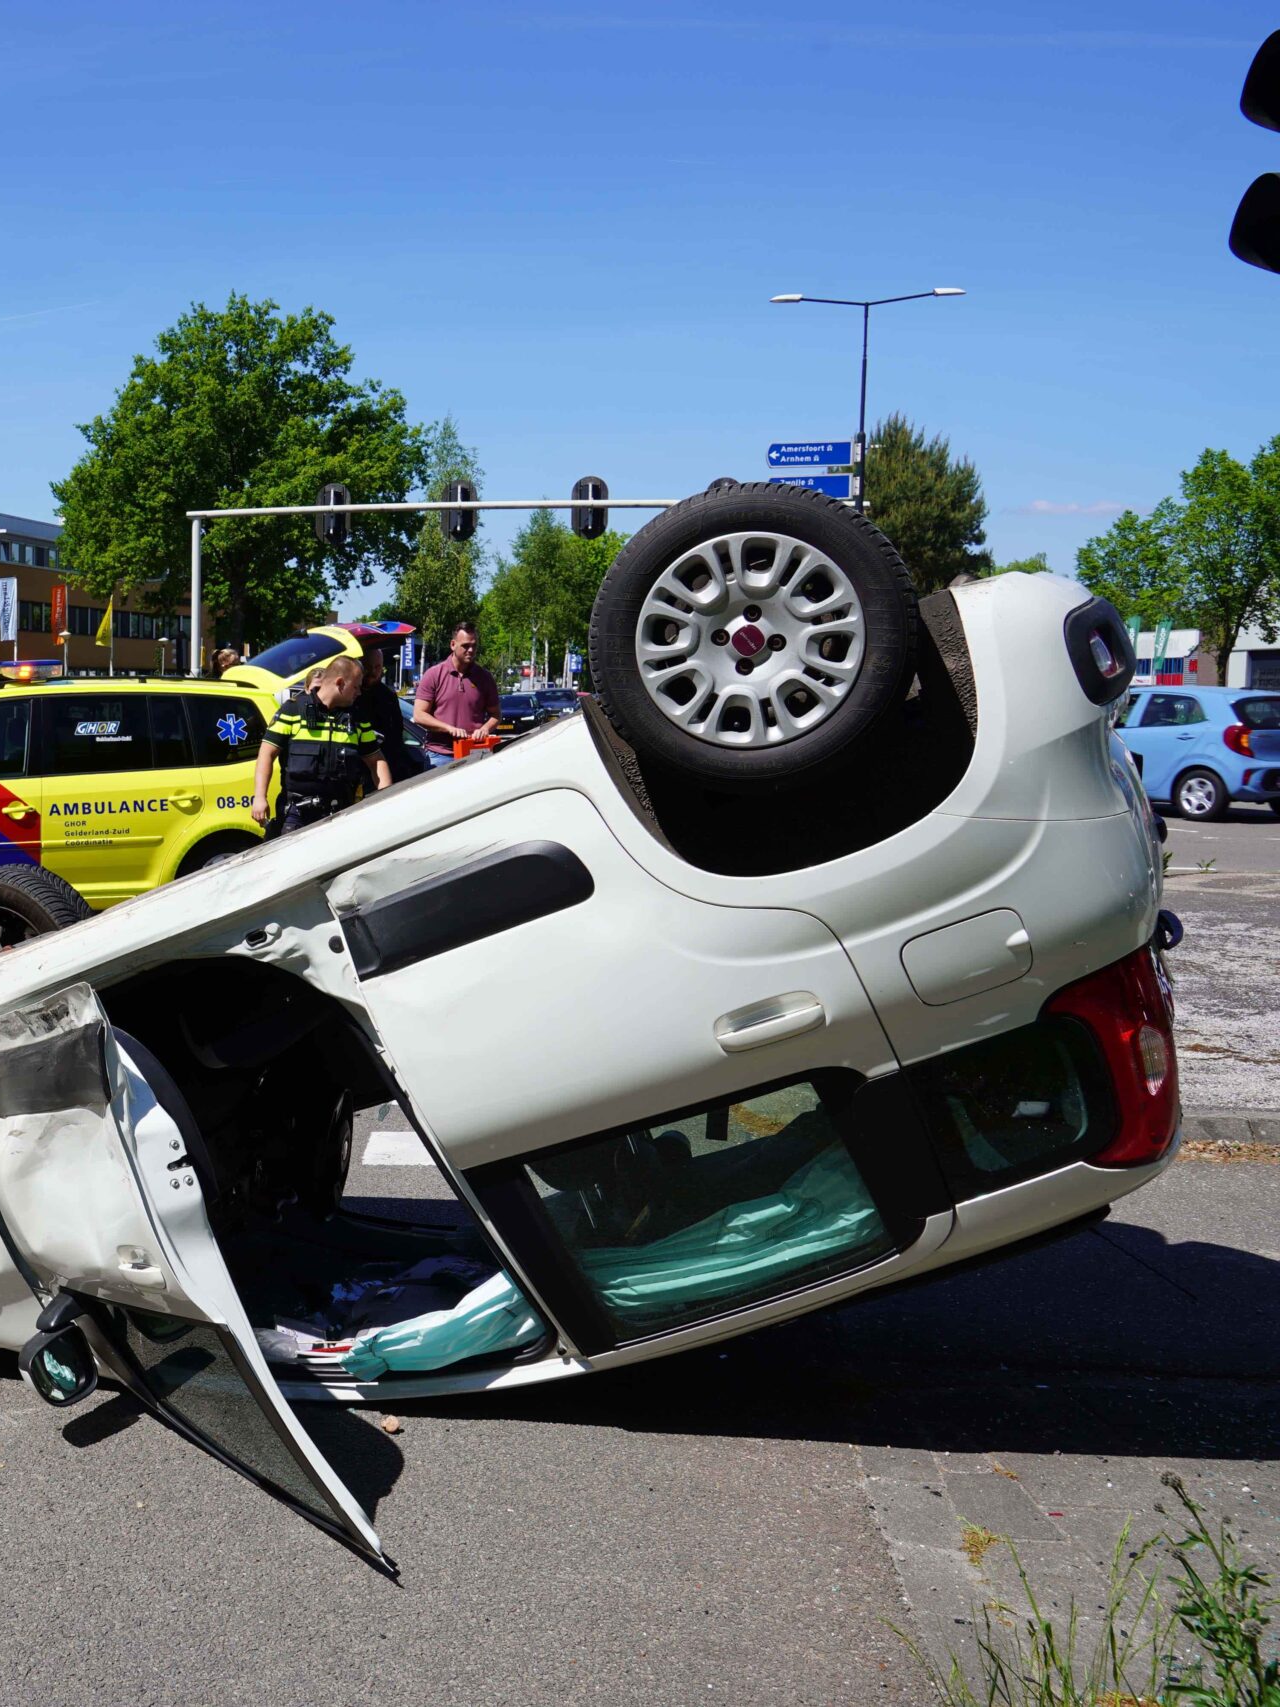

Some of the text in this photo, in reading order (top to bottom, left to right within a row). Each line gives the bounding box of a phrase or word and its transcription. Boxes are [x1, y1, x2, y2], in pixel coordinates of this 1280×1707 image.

[780, 445, 825, 453] Amersfoort
[77, 722, 117, 734] GHOR
[49, 799, 169, 816] AMBULANCE
[65, 828, 130, 837] Gelderland-Zuid
[65, 839, 113, 847] Coördinatie
